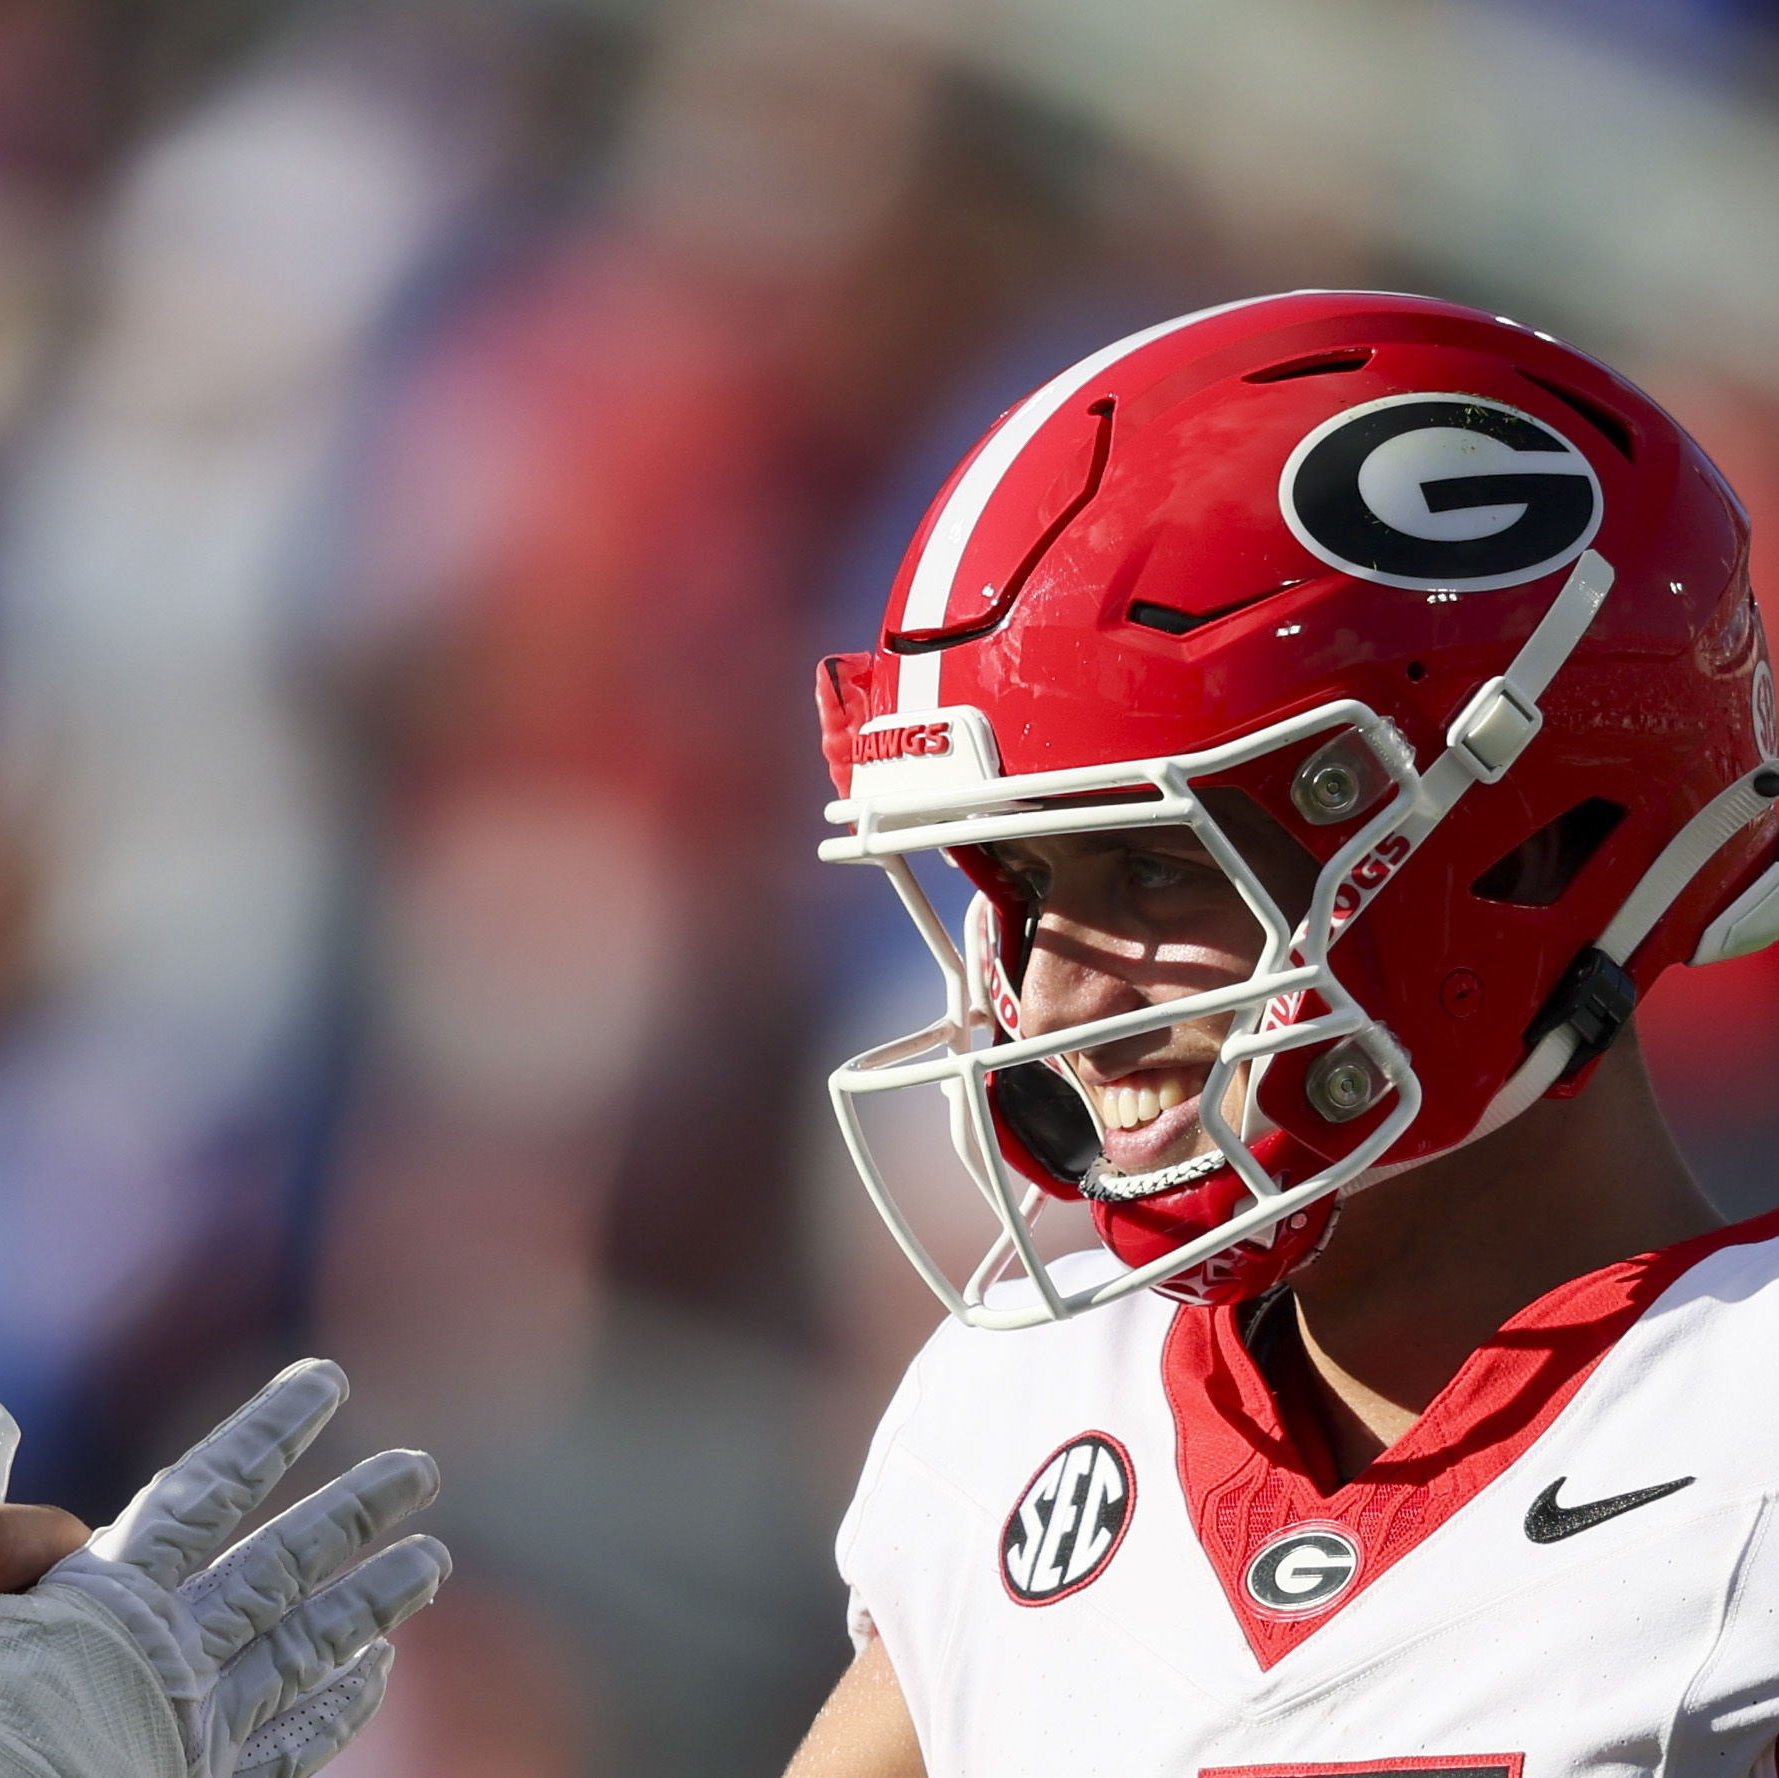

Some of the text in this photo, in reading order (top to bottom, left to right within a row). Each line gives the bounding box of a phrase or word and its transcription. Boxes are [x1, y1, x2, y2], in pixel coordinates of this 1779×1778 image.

[1292, 398, 1596, 585] G
[851, 721, 952, 765] DAWGS
[1005, 1443, 1127, 1596] SEC
[1251, 1531, 1357, 1609] G
